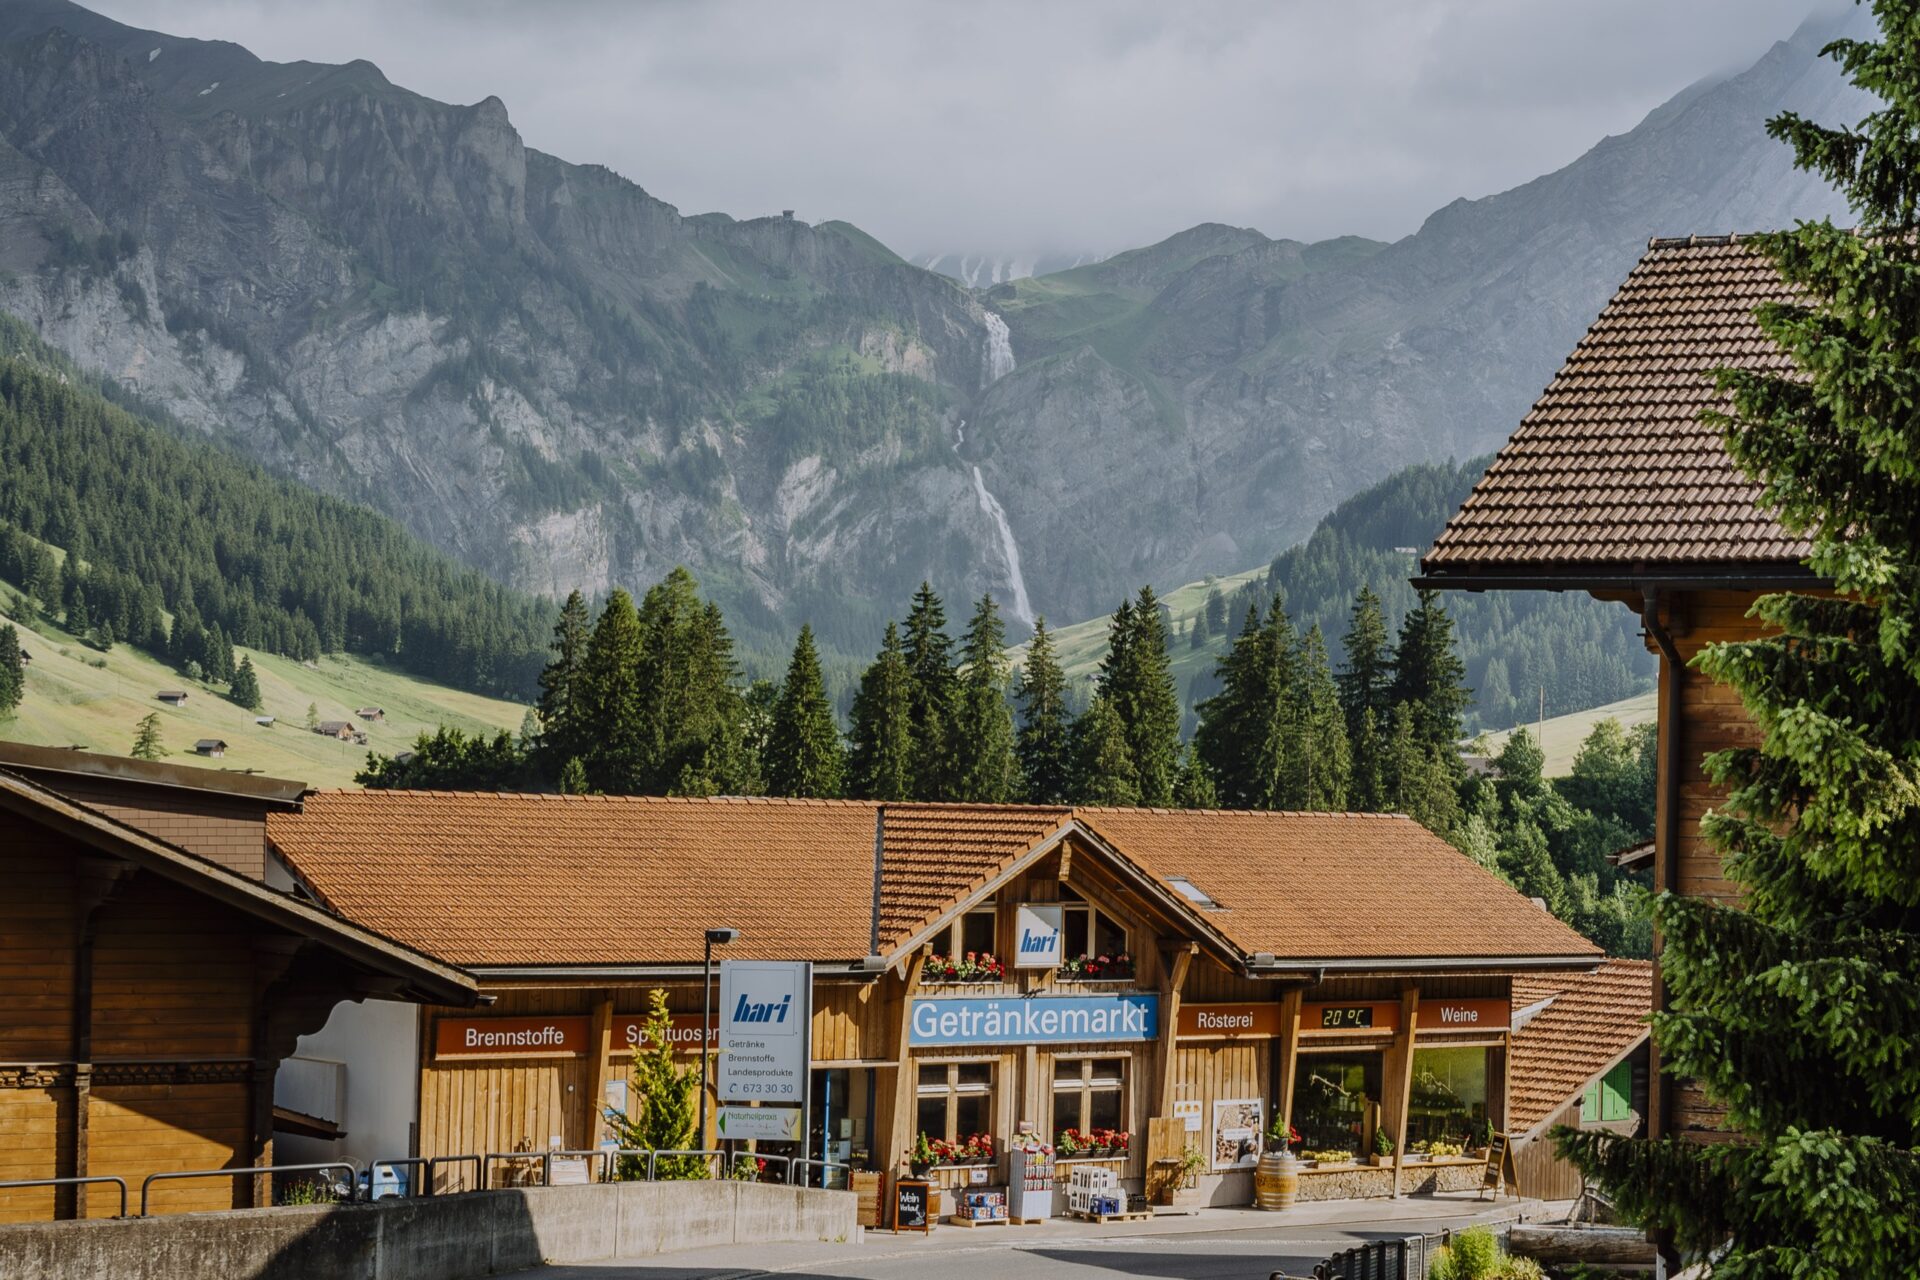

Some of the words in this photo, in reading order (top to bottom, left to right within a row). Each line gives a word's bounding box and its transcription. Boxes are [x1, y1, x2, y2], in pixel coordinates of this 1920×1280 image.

[1020, 928, 1058, 953] hari
[732, 993, 792, 1023] hari
[1441, 1007, 1478, 1023] Weine
[913, 999, 1149, 1038] Getränkemarkt
[1198, 1011, 1253, 1029] Rösterei
[1323, 1009, 1342, 1026] 20
[465, 1026, 564, 1047] Brennstoffe
[728, 1040, 765, 1049] Getränke
[728, 1053, 775, 1062] Brennstoffe
[727, 1068, 793, 1077] Landesprodukte
[743, 1083, 762, 1093] 673
[765, 1084, 778, 1093] 30
[780, 1084, 793, 1093] 30
[899, 1191, 920, 1203] Wein
